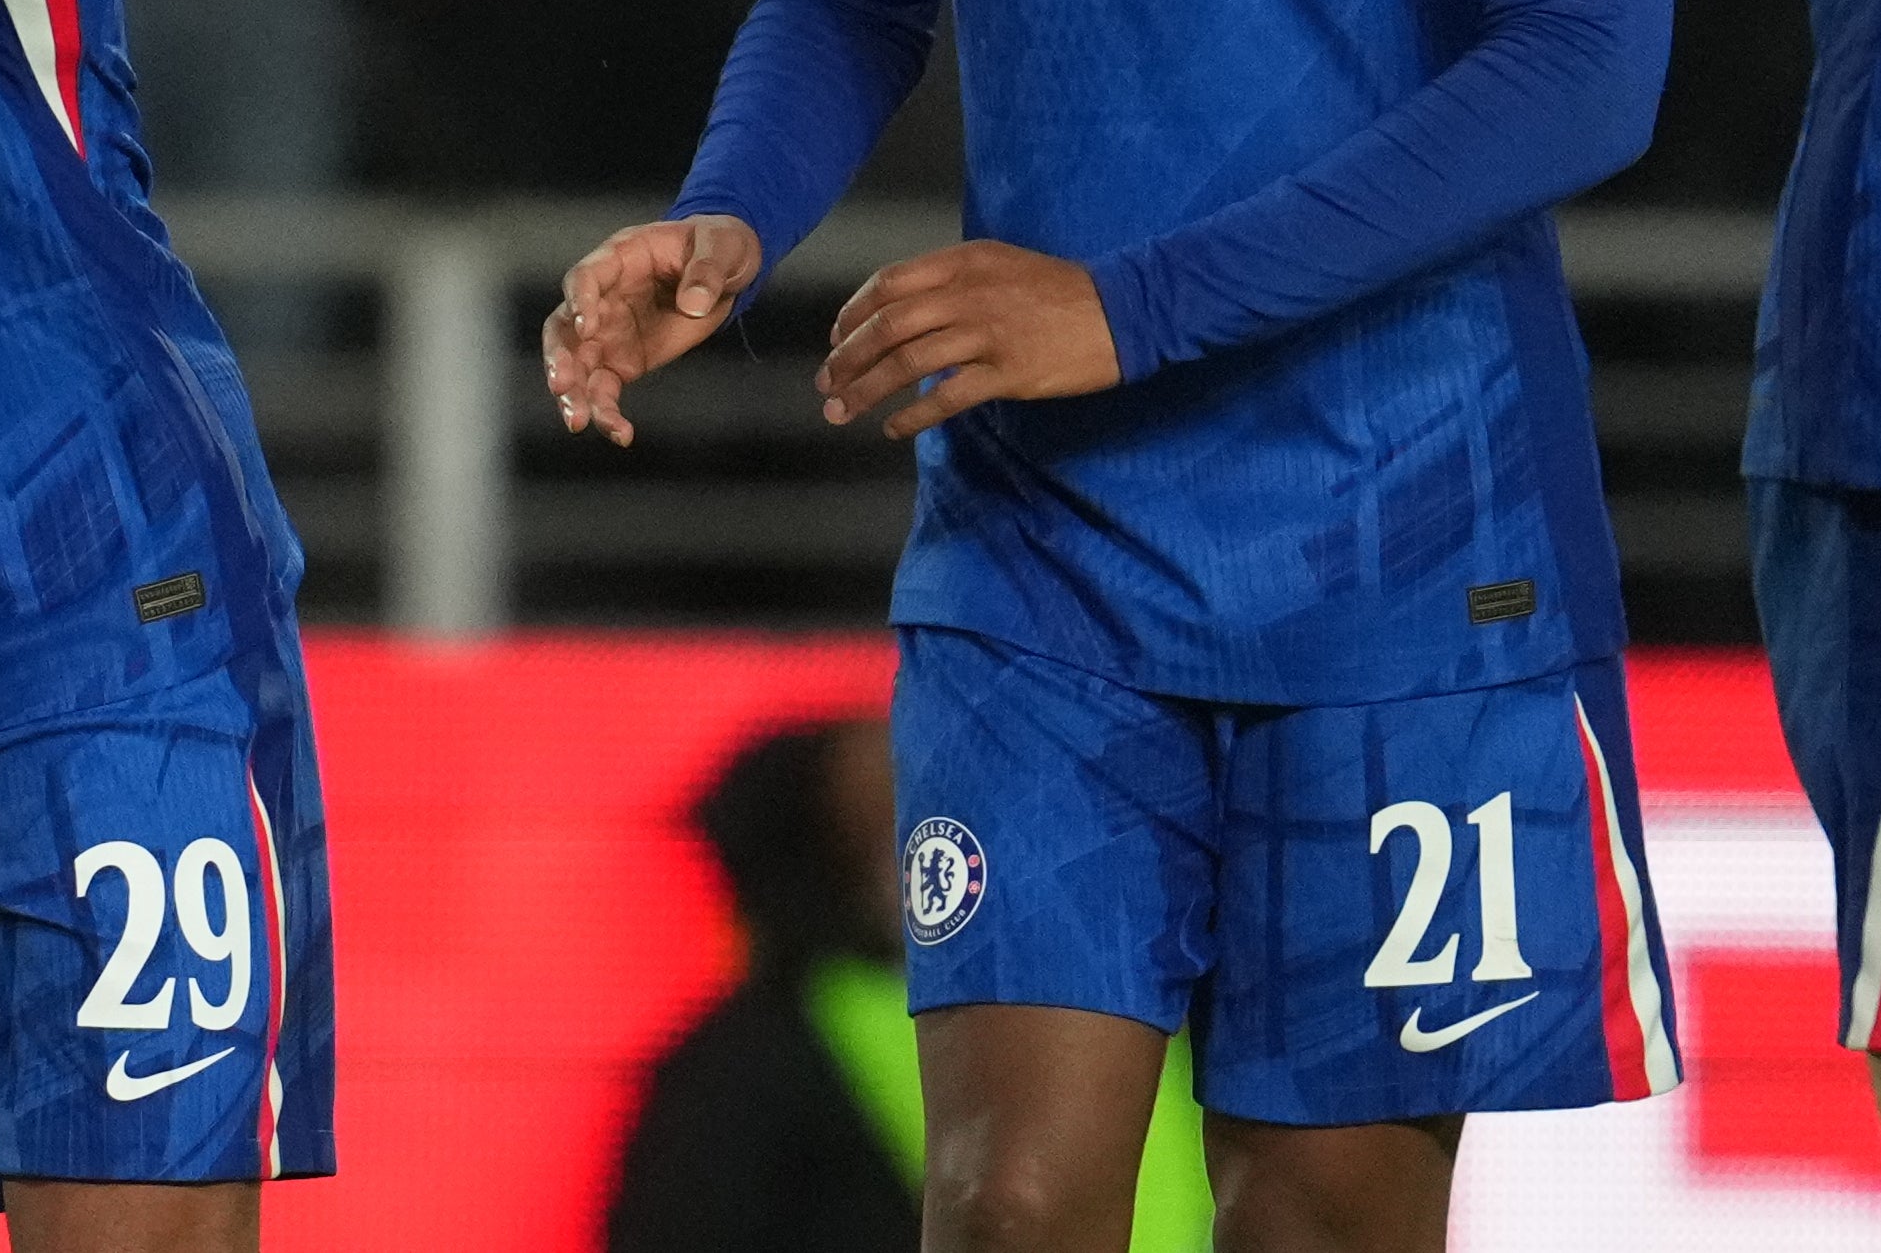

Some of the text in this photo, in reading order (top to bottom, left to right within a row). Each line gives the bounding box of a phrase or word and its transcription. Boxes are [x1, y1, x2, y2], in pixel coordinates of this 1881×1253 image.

[73, 836, 253, 1032] 29
[907, 821, 965, 856] CHELSEA
[1363, 790, 1534, 988] 21
